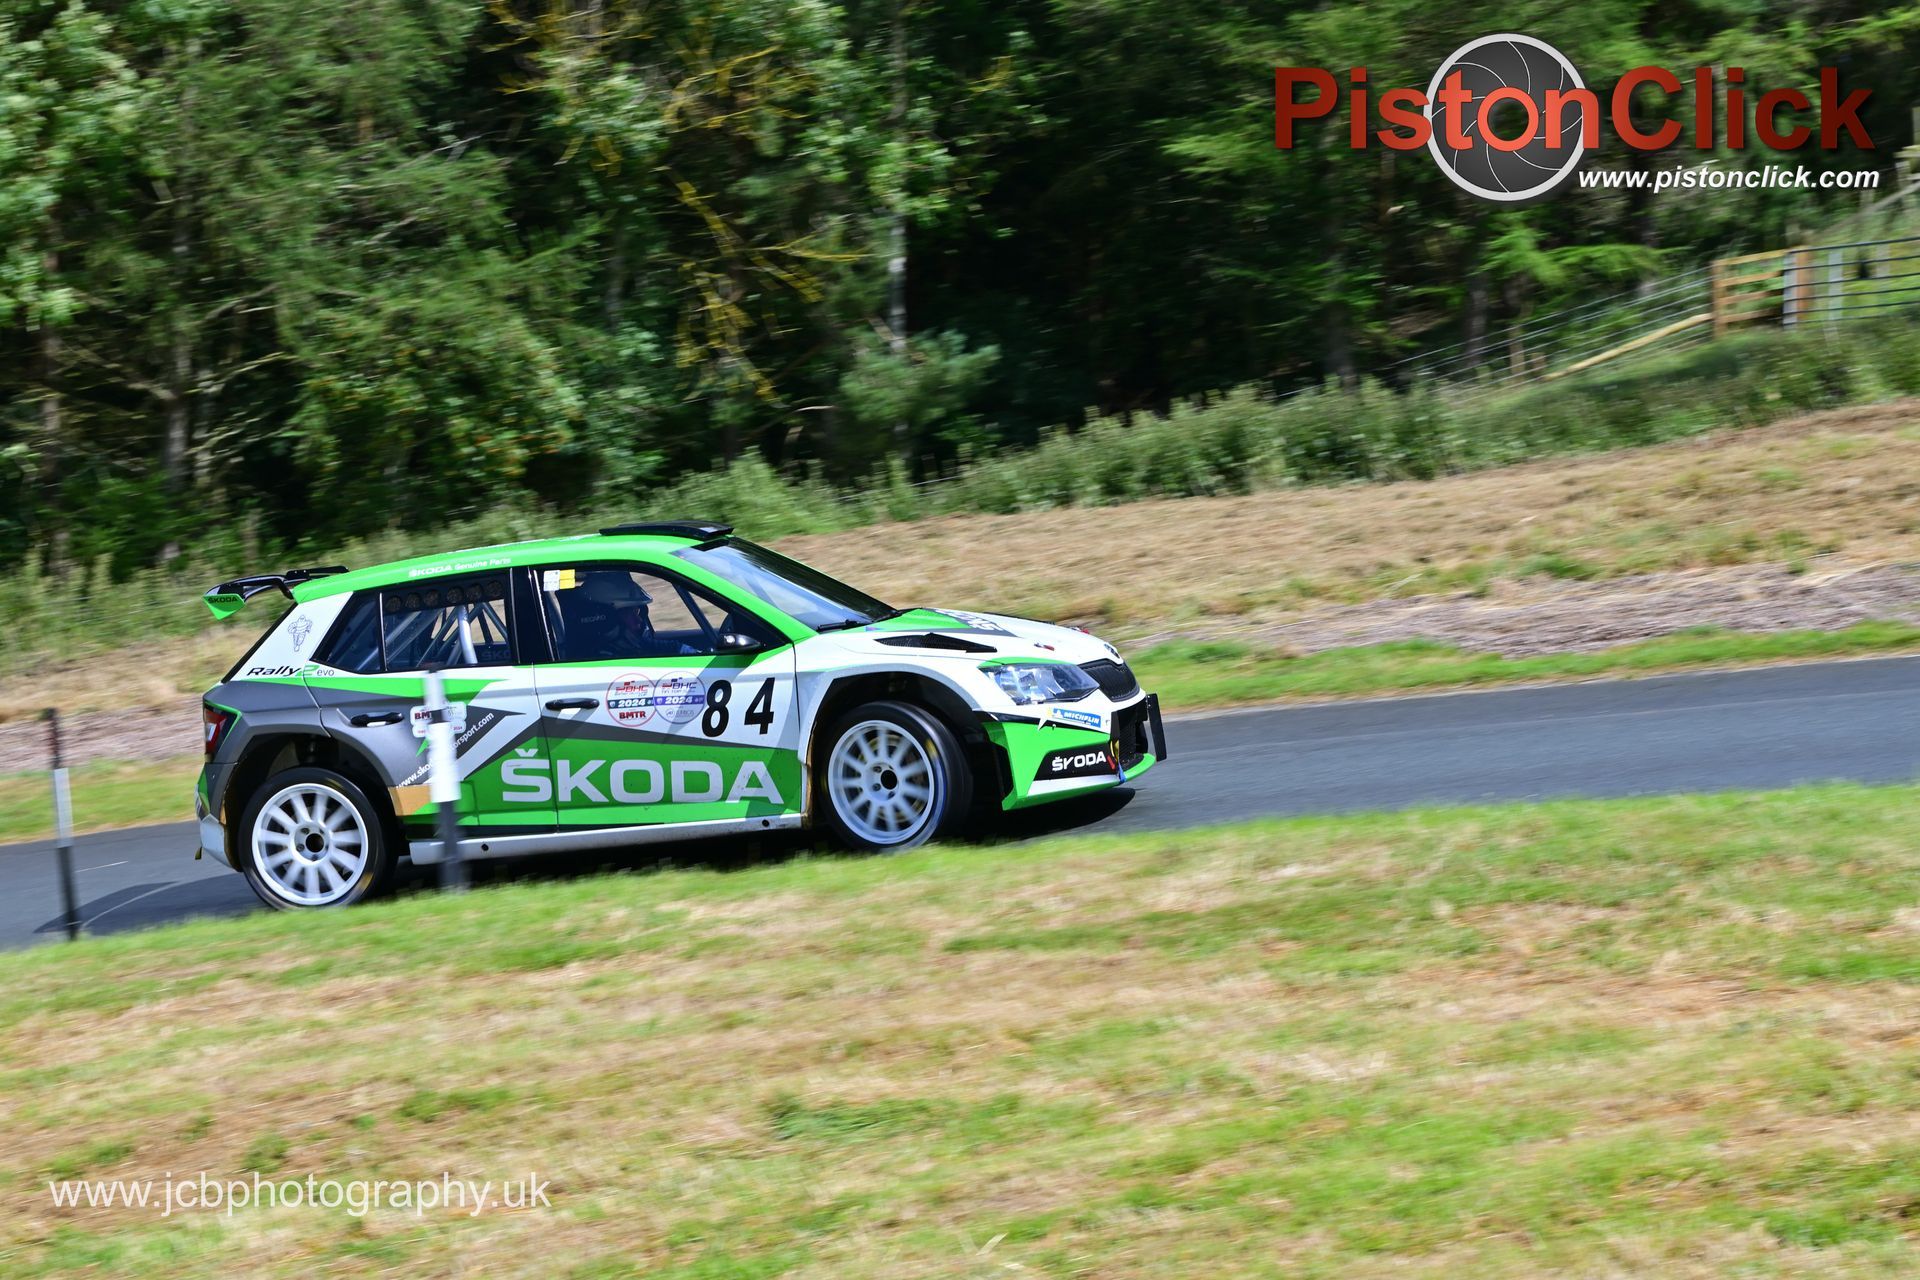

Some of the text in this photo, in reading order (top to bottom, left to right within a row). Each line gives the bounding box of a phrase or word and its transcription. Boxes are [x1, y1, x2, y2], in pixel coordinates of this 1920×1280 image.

[317, 668, 335, 676] evo
[618, 698, 646, 708] 2024
[665, 696, 693, 705] 2024
[619, 710, 646, 720] BMTR
[1063, 711, 1100, 725] MICHELIN
[501, 748, 785, 804] ŠKODA
